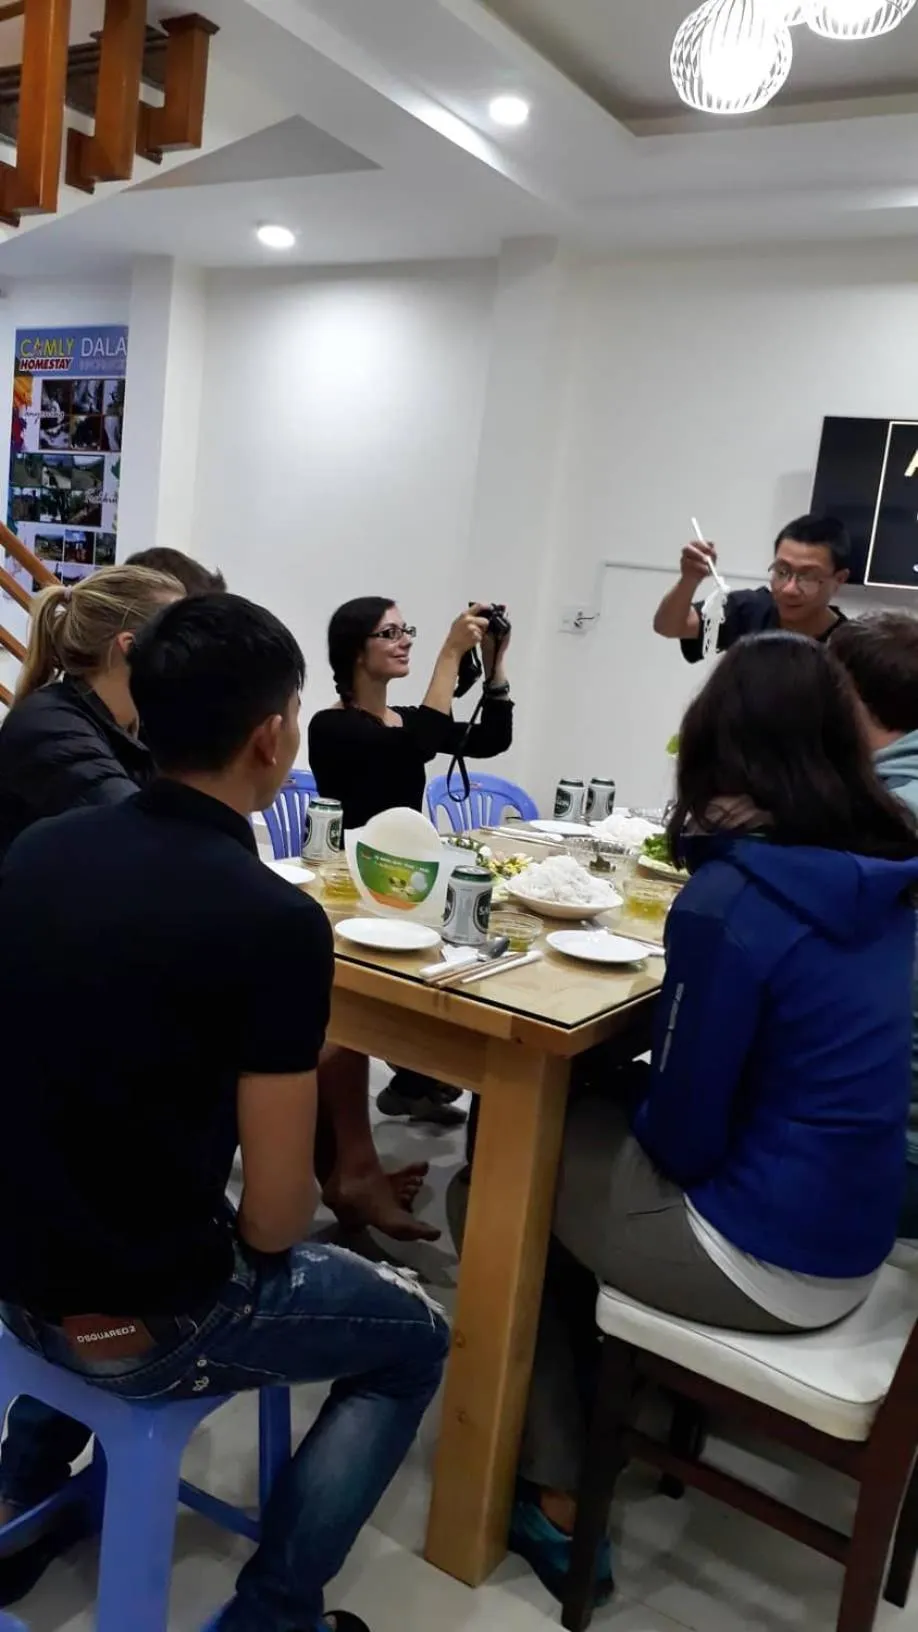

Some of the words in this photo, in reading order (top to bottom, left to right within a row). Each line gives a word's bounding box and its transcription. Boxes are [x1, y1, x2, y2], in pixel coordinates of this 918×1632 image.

[20, 337, 74, 357] CAMLY
[20, 358, 71, 370] HOMESTAY
[76, 1325, 137, 1343] DSQUARED2
